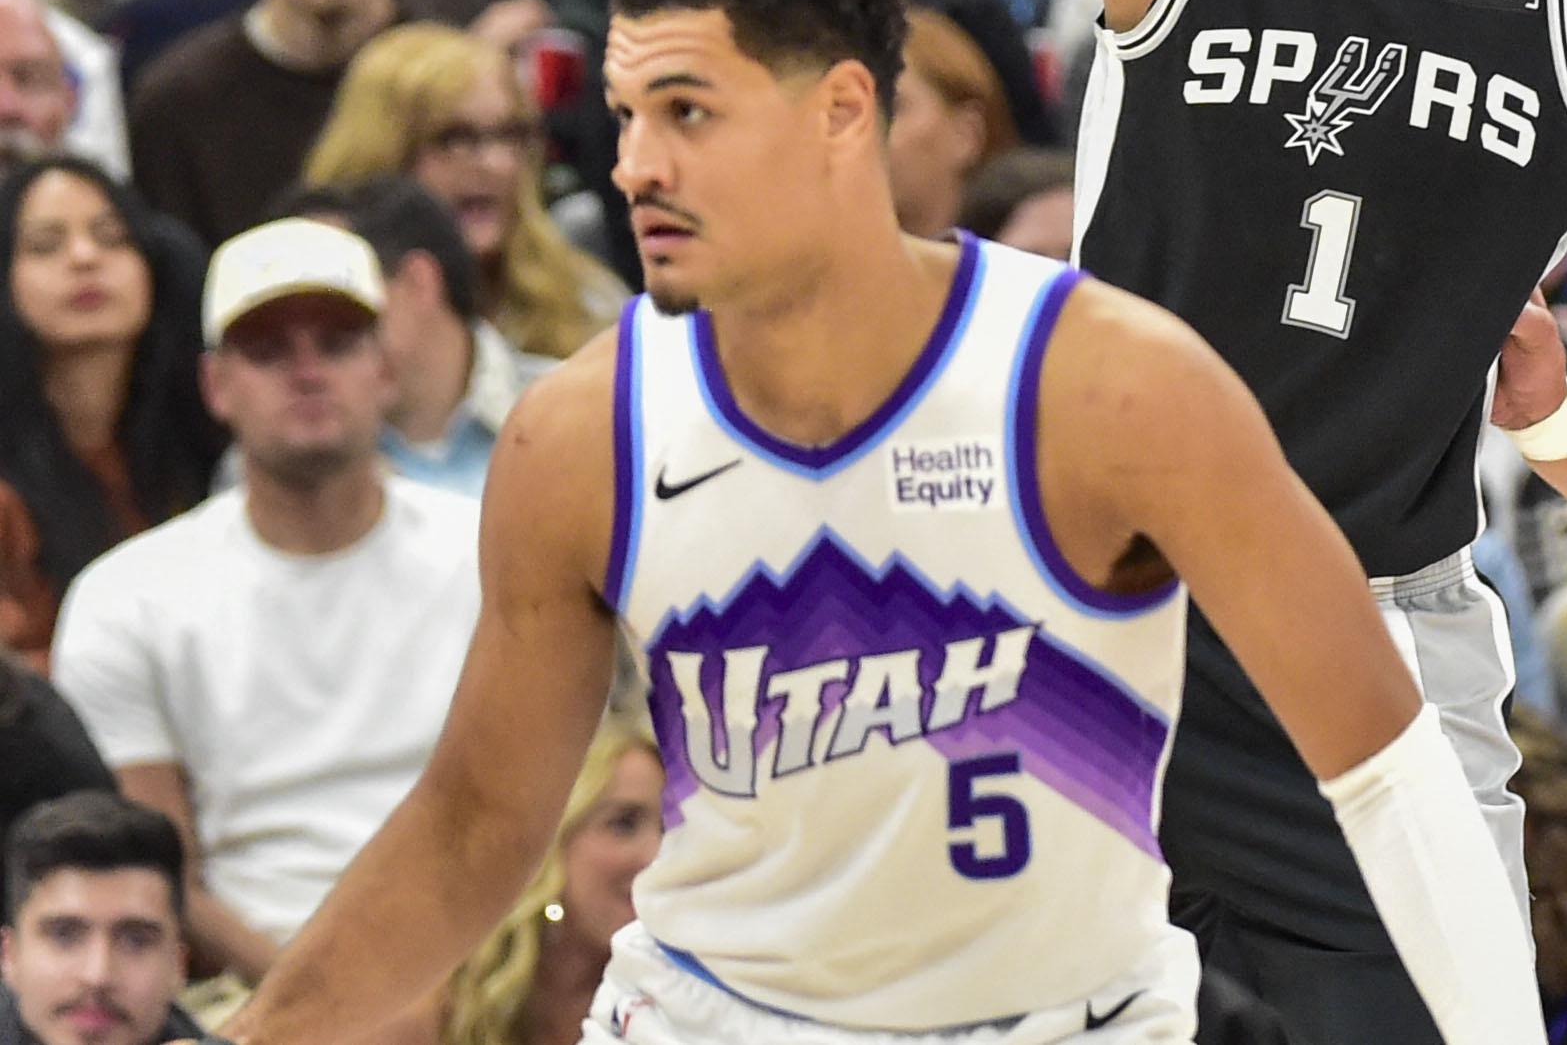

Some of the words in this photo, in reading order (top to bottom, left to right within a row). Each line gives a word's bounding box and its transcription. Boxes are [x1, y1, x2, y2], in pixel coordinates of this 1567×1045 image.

[1183, 28, 1541, 166] SPURS
[1280, 189, 1363, 340] 1
[893, 441, 993, 474] Health
[896, 474, 994, 507] Equity
[666, 621, 1044, 799] UTAH
[947, 753, 1031, 880] 5
